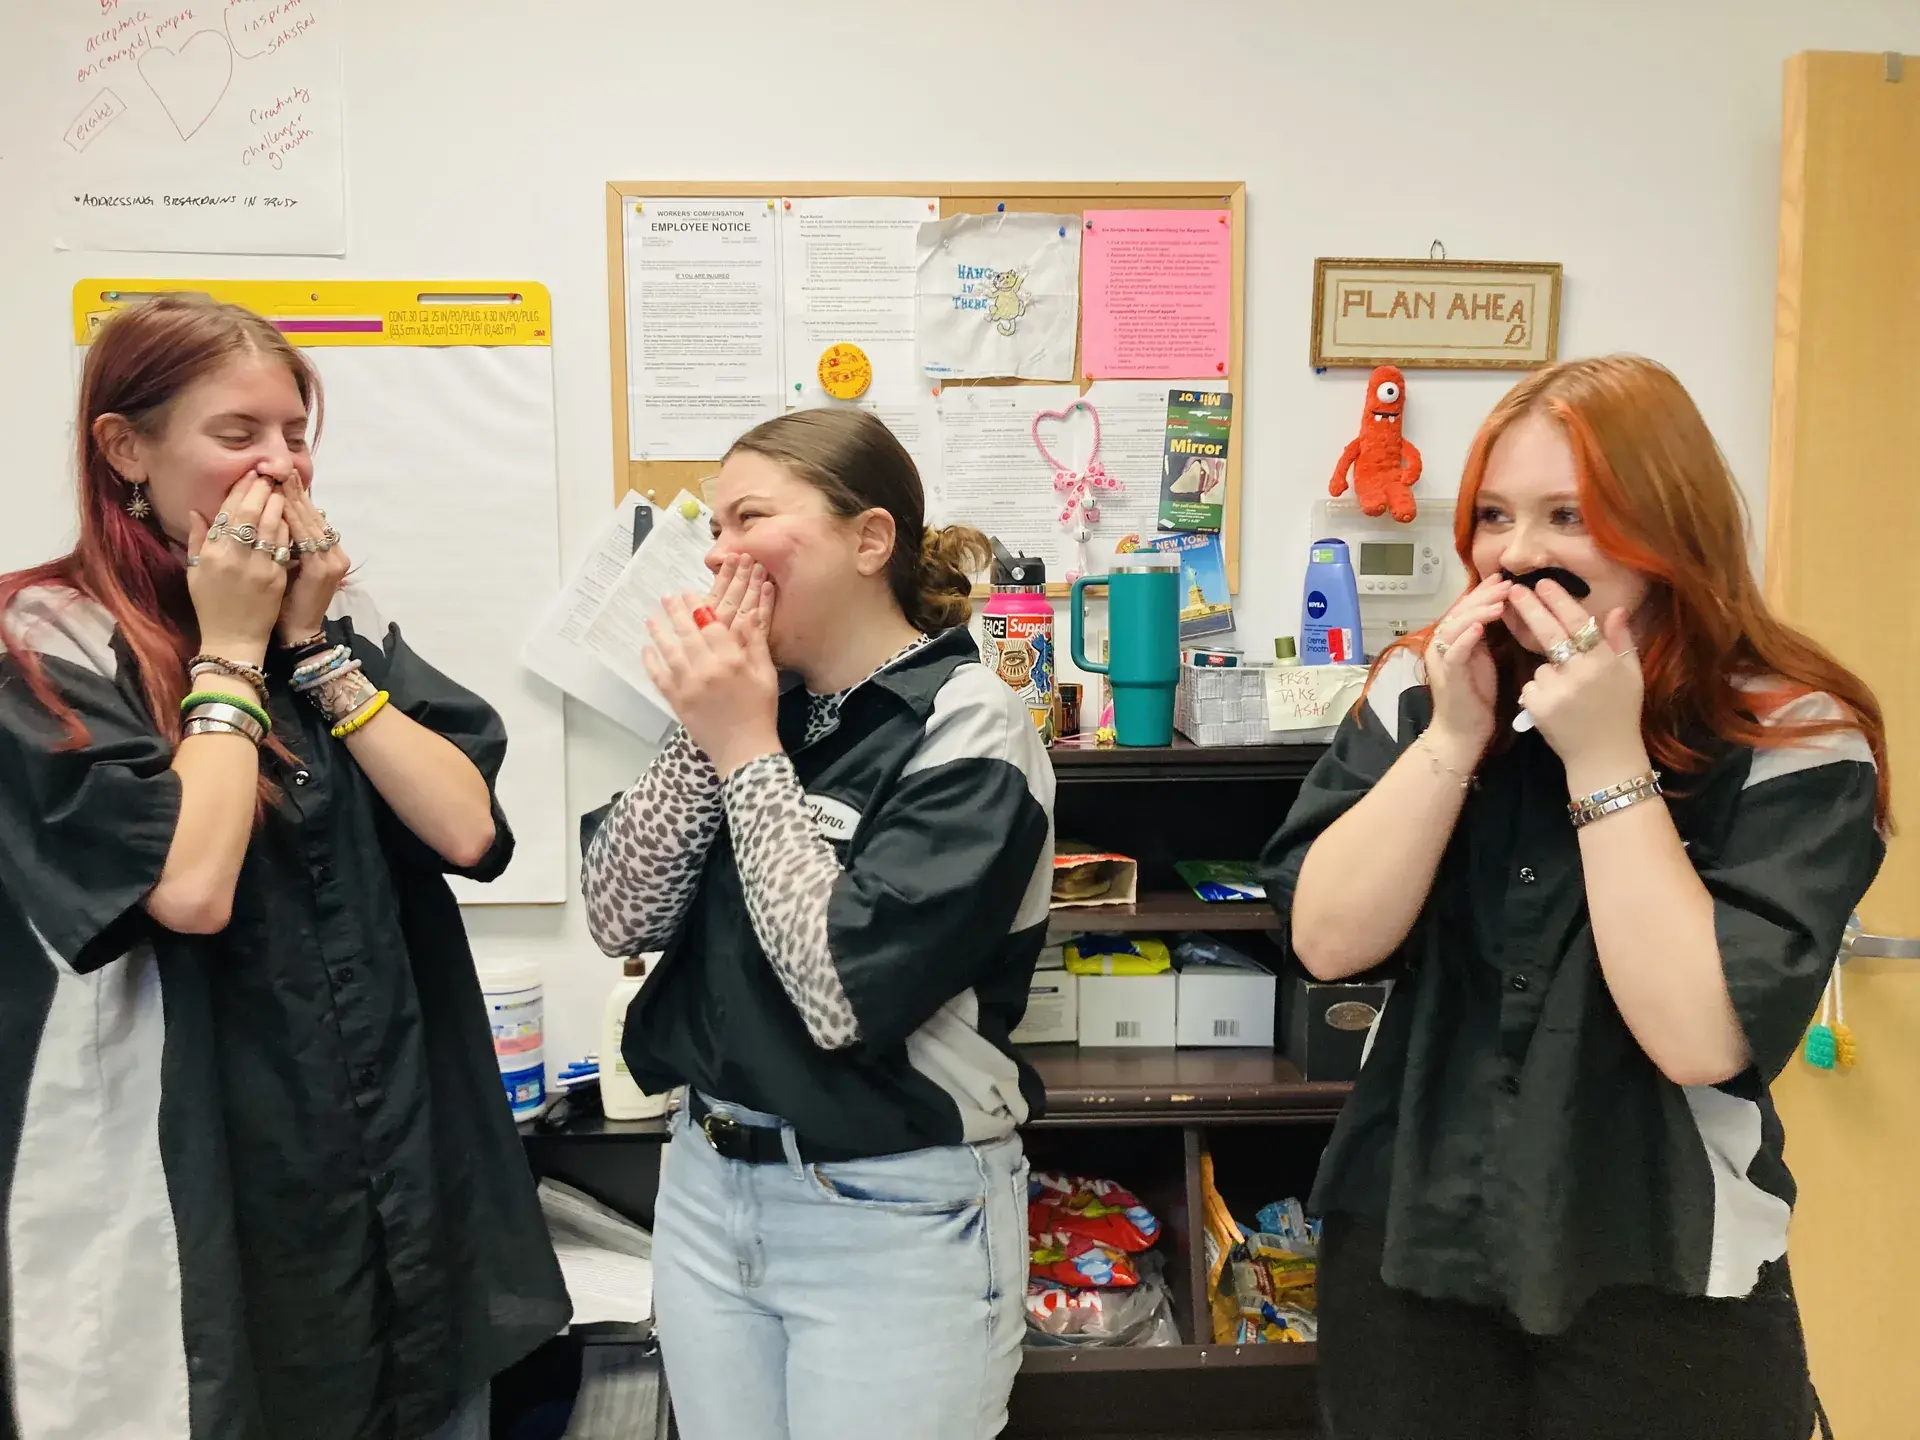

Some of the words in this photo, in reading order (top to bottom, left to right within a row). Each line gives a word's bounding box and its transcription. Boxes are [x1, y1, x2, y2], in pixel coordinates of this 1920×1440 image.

[651, 222, 709, 232] EMPLOYEE
[712, 222, 752, 232] NOTICE
[957, 264, 997, 280] HANG
[962, 283, 974, 293] IN
[952, 297, 989, 310] THERE
[1342, 290, 1436, 319] PLAN
[1169, 438, 1223, 455] Mirror
[1156, 538, 1178, 551] NEW
[1181, 533, 1209, 545] YORK
[1307, 637, 1327, 645] Creme
[1275, 688, 1317, 703] TAKE
[1294, 702, 1331, 718] ASAP
